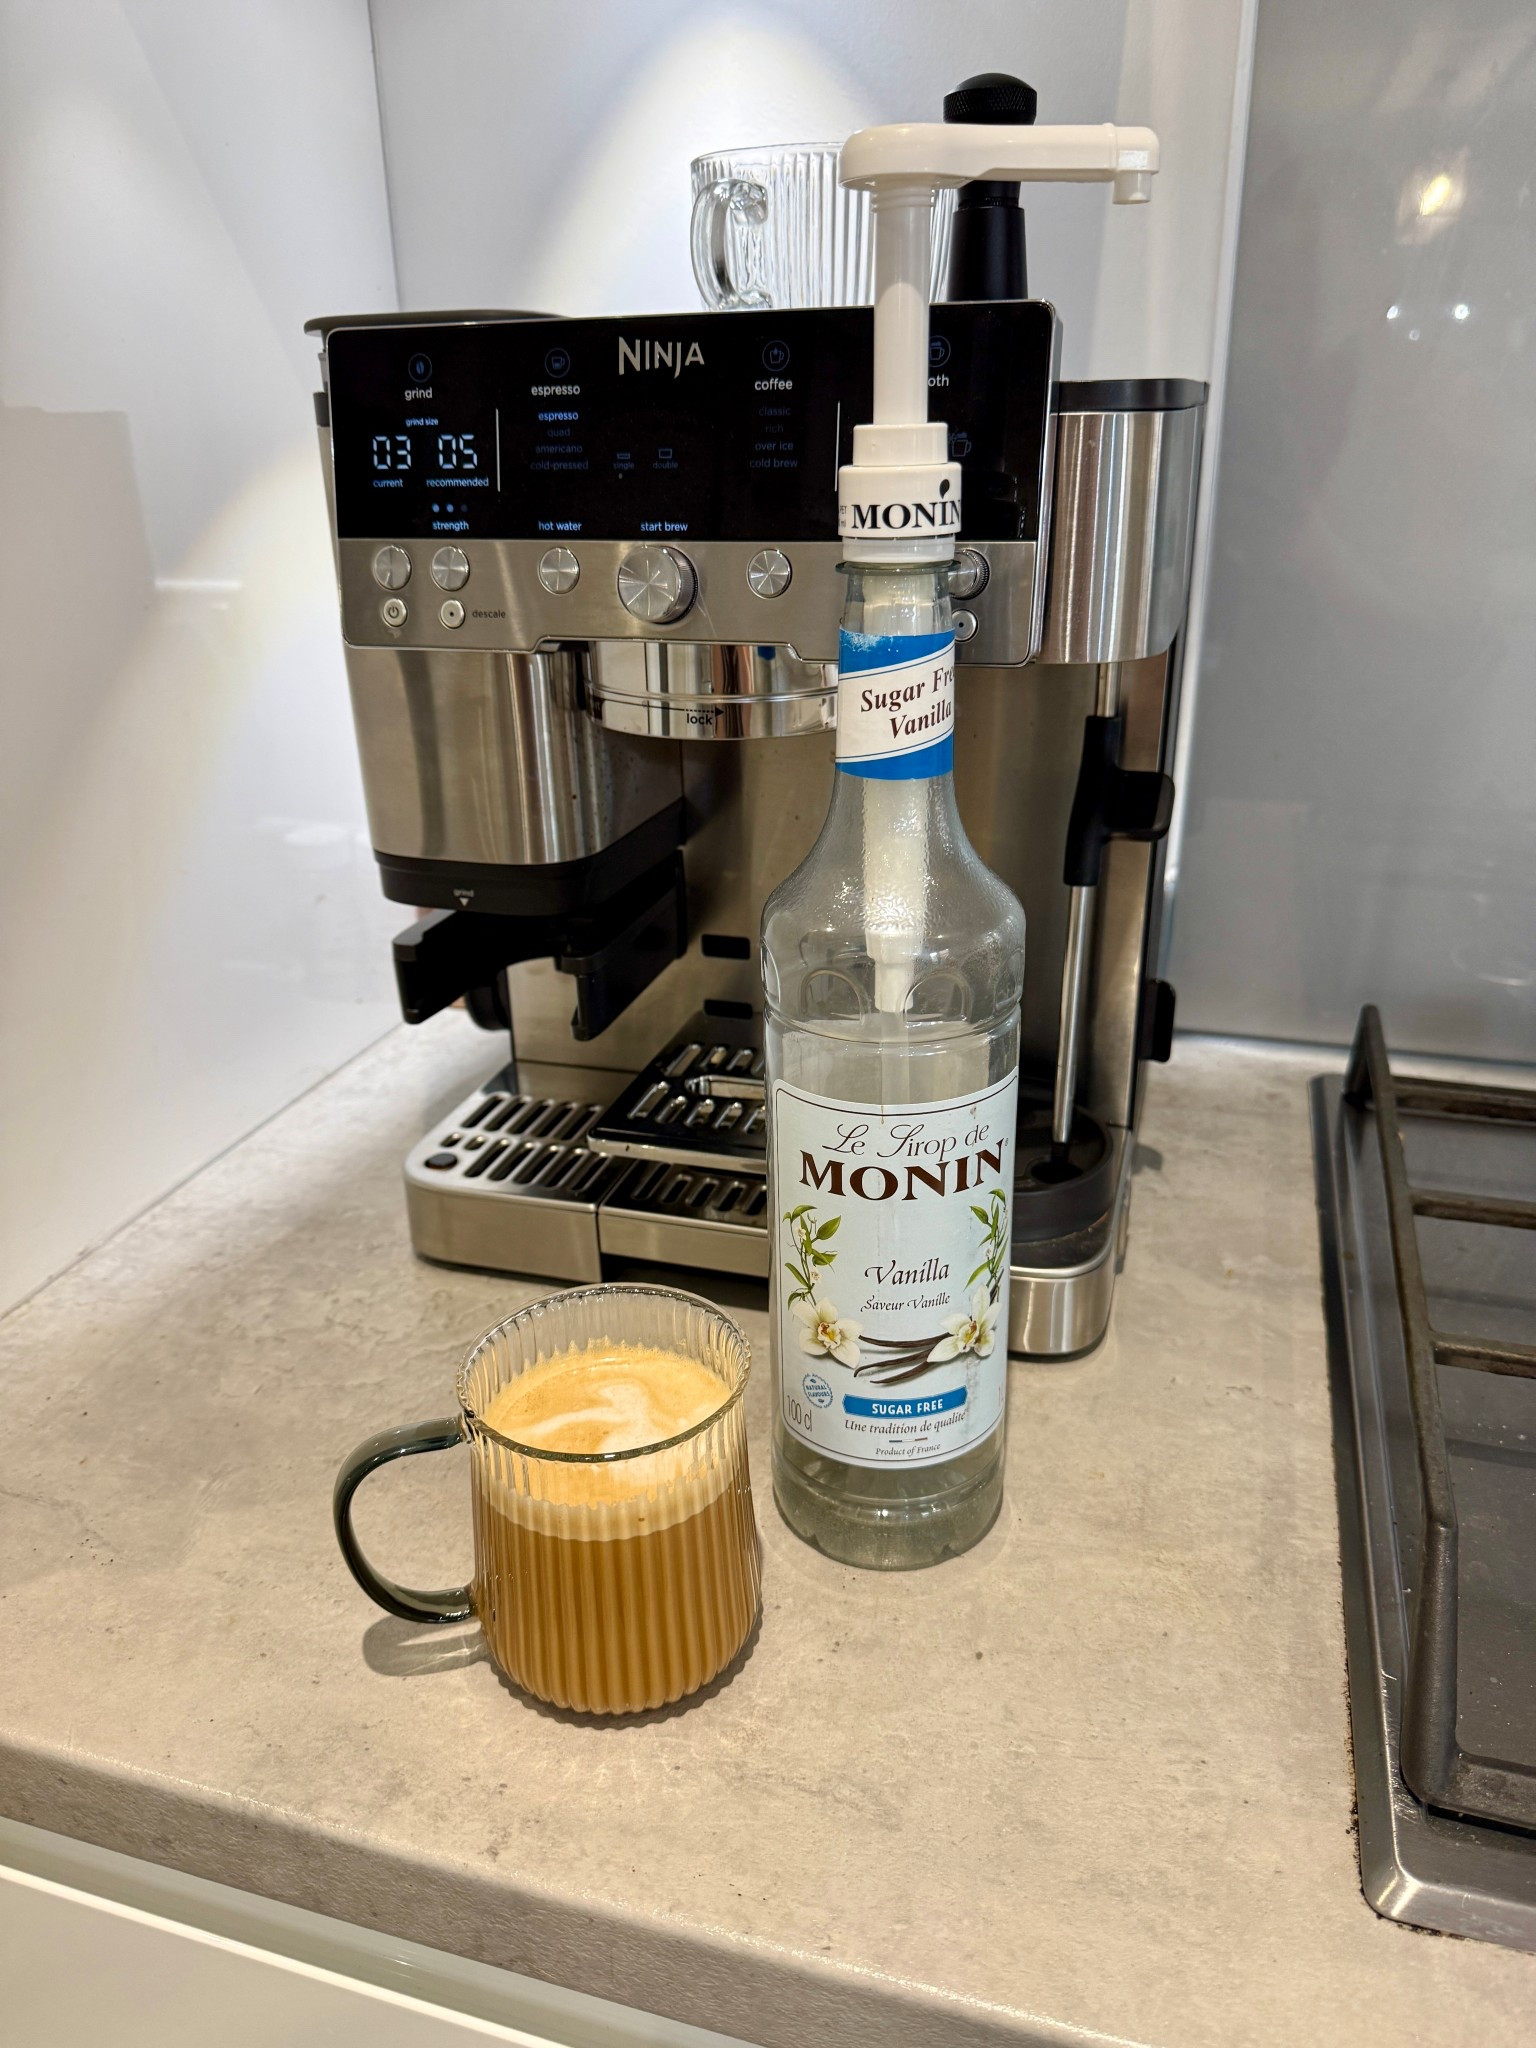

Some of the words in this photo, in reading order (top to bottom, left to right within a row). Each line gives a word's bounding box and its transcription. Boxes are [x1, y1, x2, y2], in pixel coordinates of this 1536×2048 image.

[618, 336, 705, 379] NINJA
[754, 378, 794, 391] coffee
[927, 373, 950, 387] oth
[404, 387, 433, 401] grind
[530, 384, 581, 398] espresso
[538, 411, 579, 422] espresso
[758, 405, 792, 417] classic
[405, 417, 424, 428] grind
[425, 417, 439, 426] size
[765, 424, 784, 434] rich
[546, 427, 571, 439] quad
[372, 435, 412, 470] 03
[438, 433, 478, 470] 05
[535, 444, 583, 455] americano
[754, 441, 777, 451] over
[779, 440, 795, 451] ice
[529, 459, 590, 471] cold-pressed
[652, 459, 679, 470] double
[750, 457, 771, 469] cold
[773, 457, 799, 468] brew
[372, 478, 404, 488] current
[426, 477, 490, 488] recommended
[851, 500, 961, 530] MONIN
[432, 520, 470, 532] strength
[538, 520, 554, 532] hot
[556, 521, 583, 532] water
[640, 520, 663, 532] start
[664, 520, 689, 532] brew
[472, 610, 506, 619] descale
[860, 682, 926, 713] Sugar
[932, 666, 956, 694] Fre
[686, 712, 713, 726] lock
[889, 698, 952, 739] Vanilla
[822, 1123, 869, 1156] Le
[876, 1123, 957, 1162] Sirop
[964, 1123, 990, 1147] de
[799, 1137, 1005, 1201] MONIN
[864, 1257, 950, 1286] Vanilla
[860, 1294, 905, 1312] Saveur
[906, 1291, 951, 1309] Vanille
[787, 1395, 802, 1425] 100
[804, 1409, 813, 1432] cl
[871, 1403, 912, 1416] SUGAR
[917, 1398, 943, 1413] FREE
[844, 1419, 867, 1432] Une
[869, 1421, 917, 1435] tradition
[919, 1419, 932, 1432] de
[875, 1447, 905, 1456] Product
[906, 1446, 915, 1457] of
[917, 1443, 941, 1455] France
